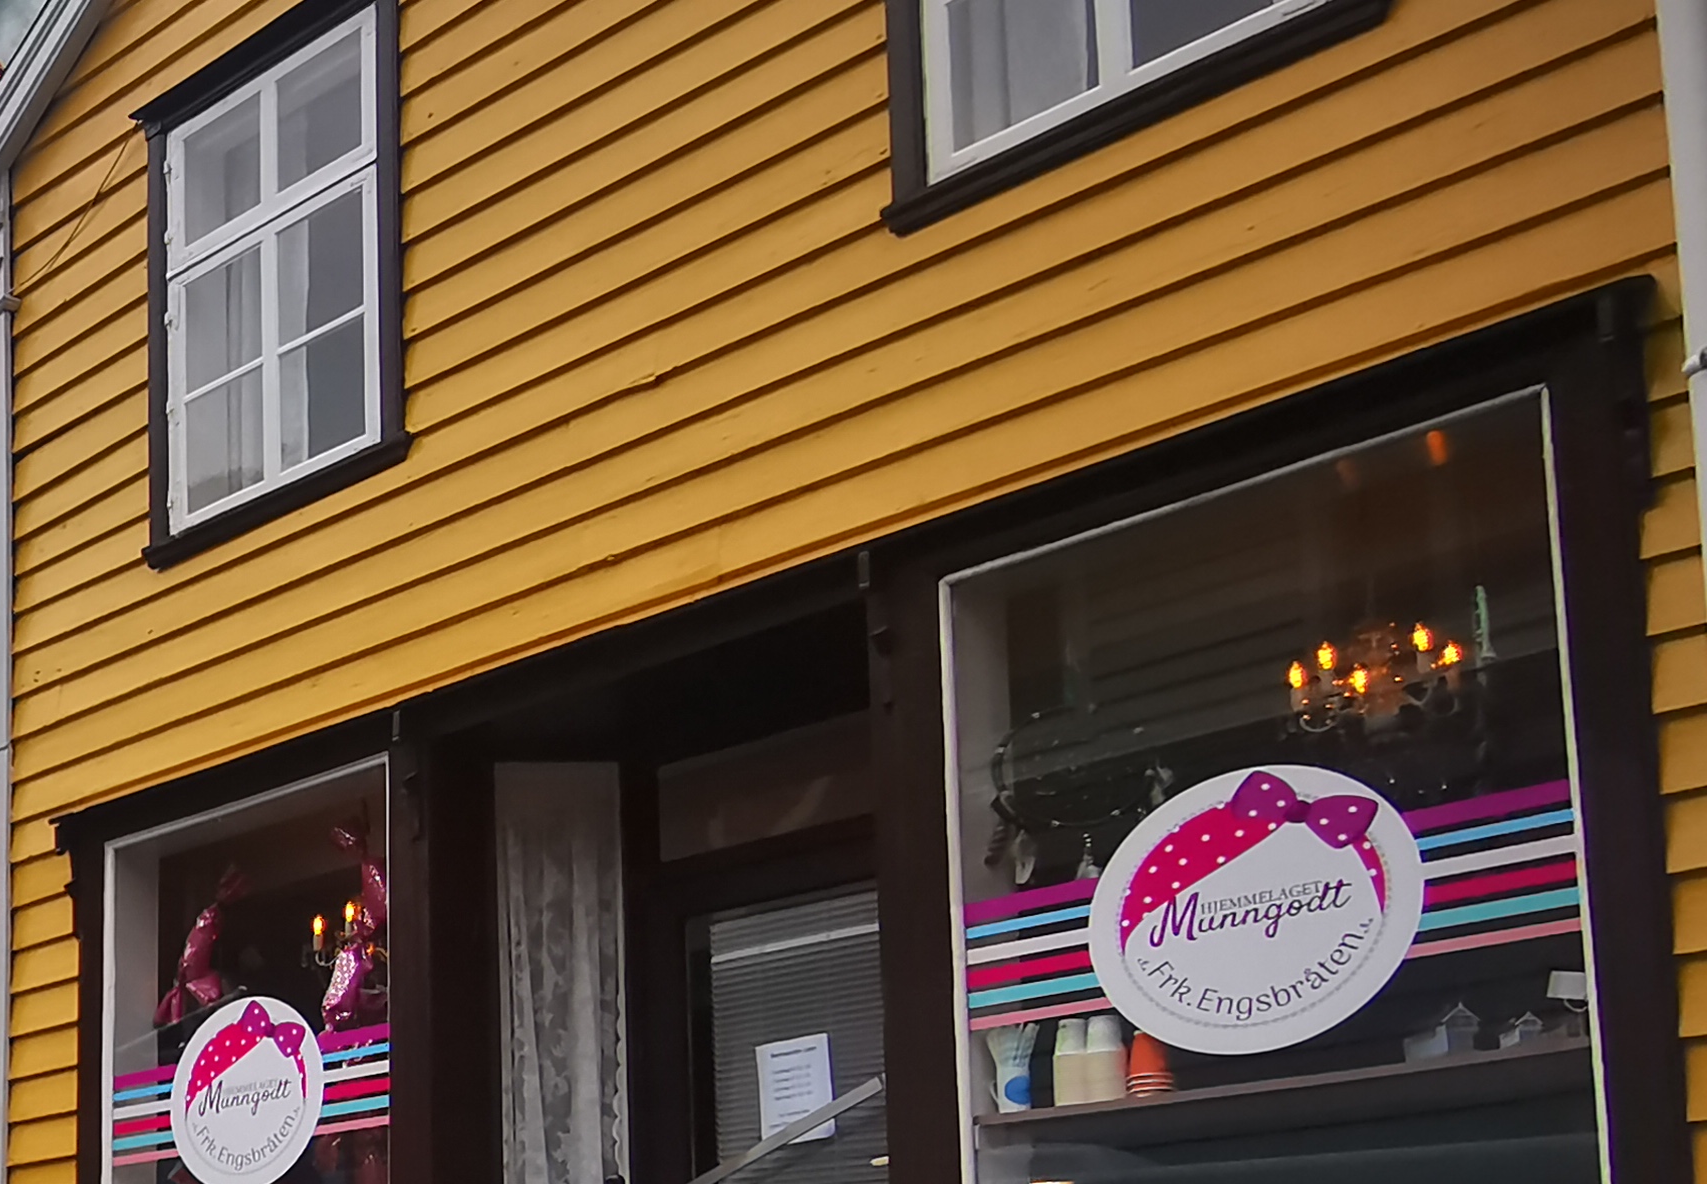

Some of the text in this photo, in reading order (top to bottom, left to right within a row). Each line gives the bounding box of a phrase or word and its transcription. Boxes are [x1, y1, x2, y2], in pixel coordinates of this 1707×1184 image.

[1149, 879, 1352, 947] Munngodt
[1200, 880, 1323, 915] HJEMMELAGET
[198, 1079, 292, 1116] Munngodt
